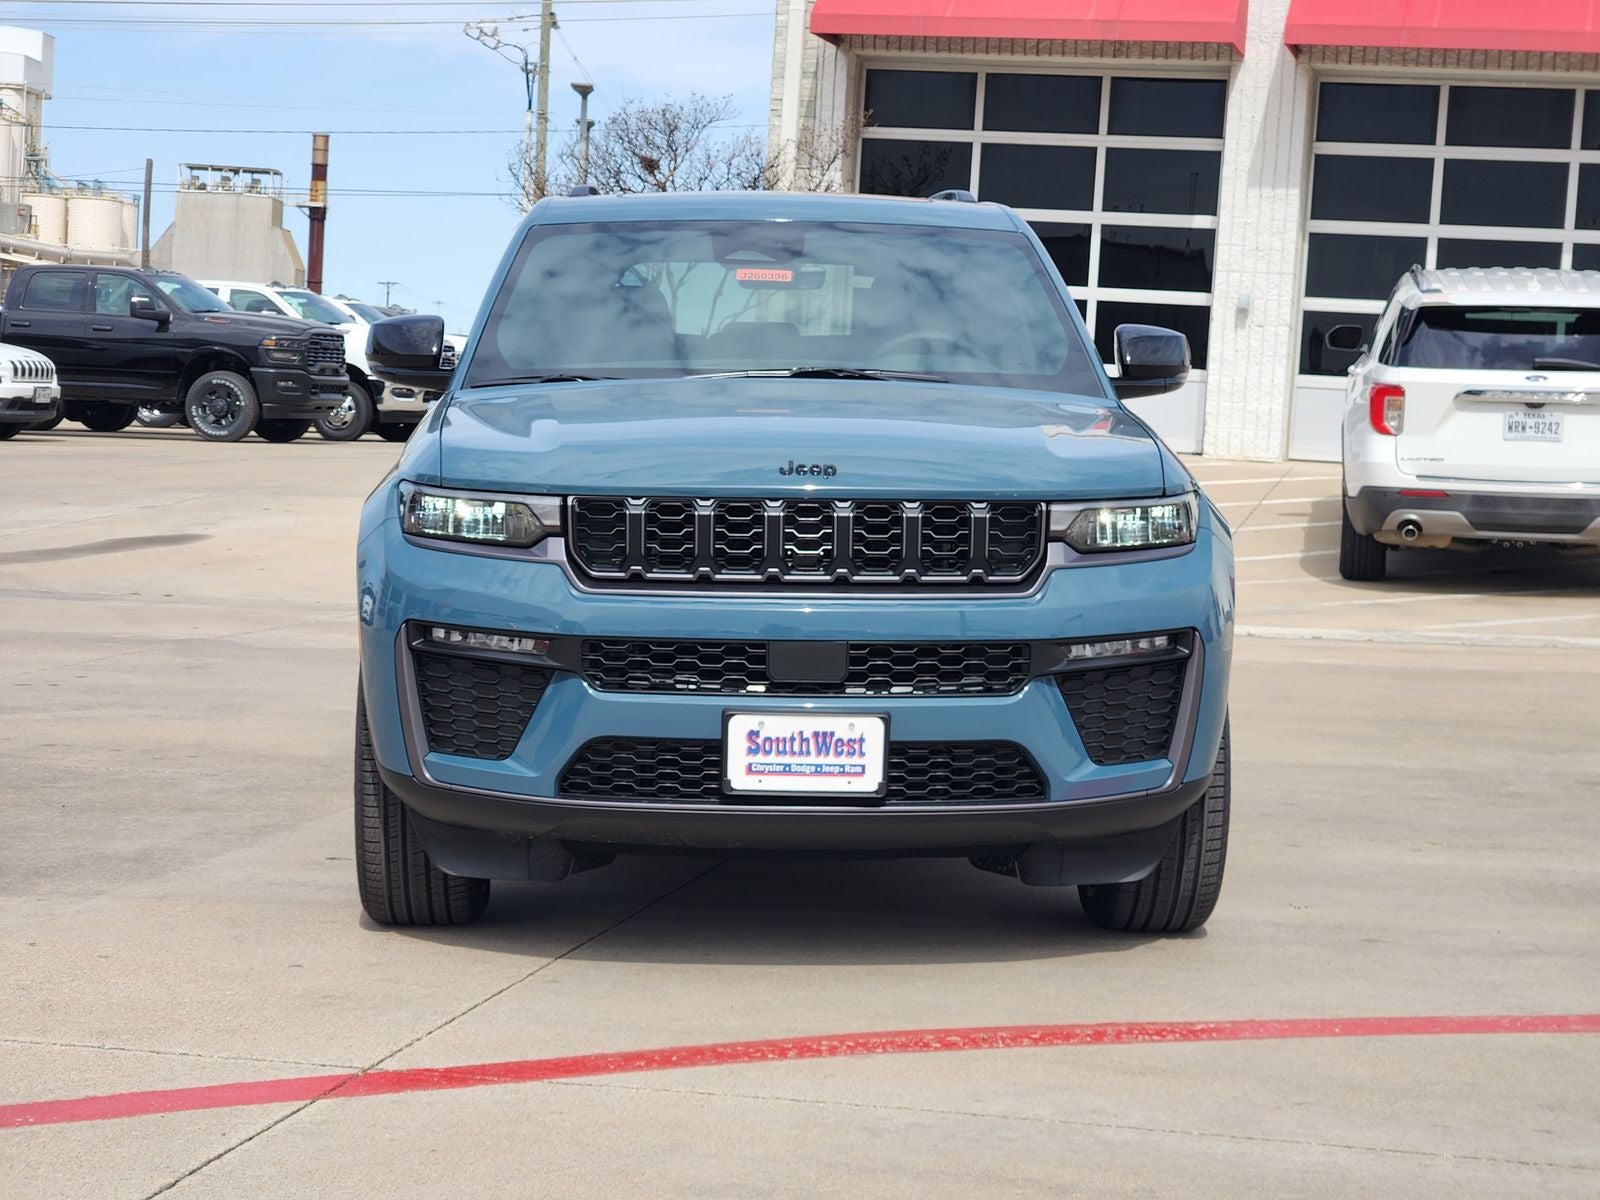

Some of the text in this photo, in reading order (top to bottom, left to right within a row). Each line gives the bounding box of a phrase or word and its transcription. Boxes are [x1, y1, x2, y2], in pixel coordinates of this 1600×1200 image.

[778, 460, 837, 479] Jeep
[746, 729, 866, 757] SouthWest
[751, 763, 863, 775] Chrysler Dodge Jeep Ram
